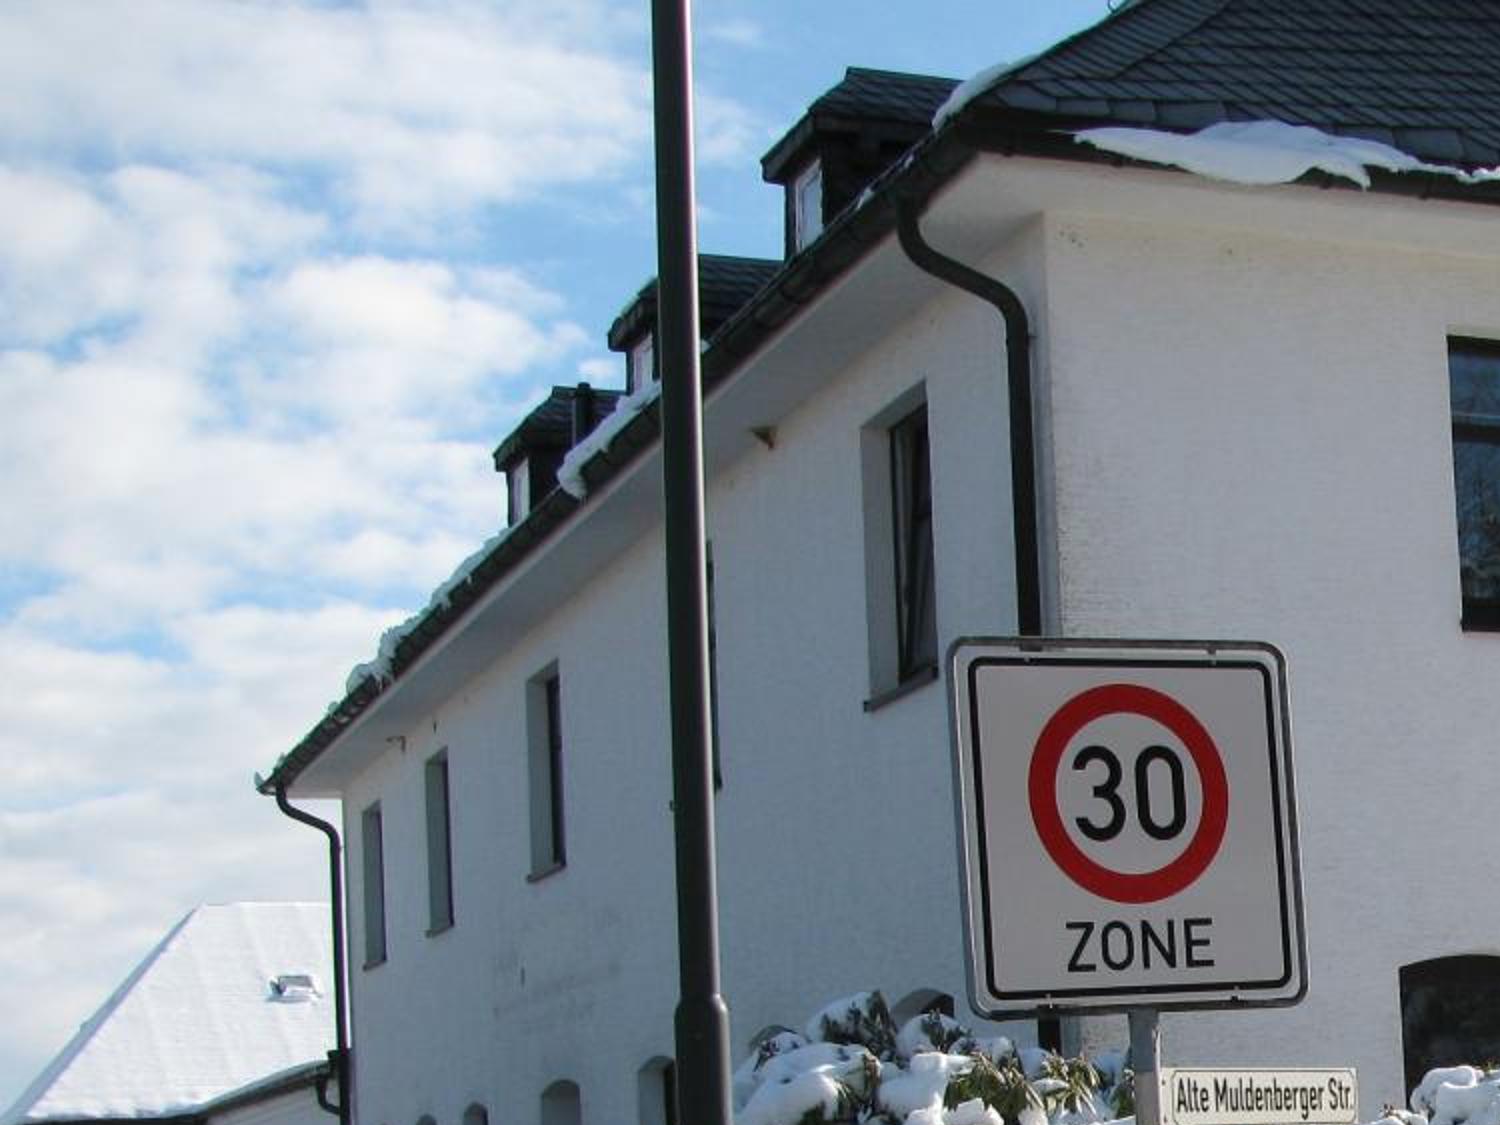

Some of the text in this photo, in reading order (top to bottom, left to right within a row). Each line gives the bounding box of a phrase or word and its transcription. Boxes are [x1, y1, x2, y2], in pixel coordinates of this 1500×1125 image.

[1072, 745, 1187, 842] 30
[1066, 917, 1215, 973] ZONE
[1177, 1077, 1354, 1120] Alte Muldenberger Str.
